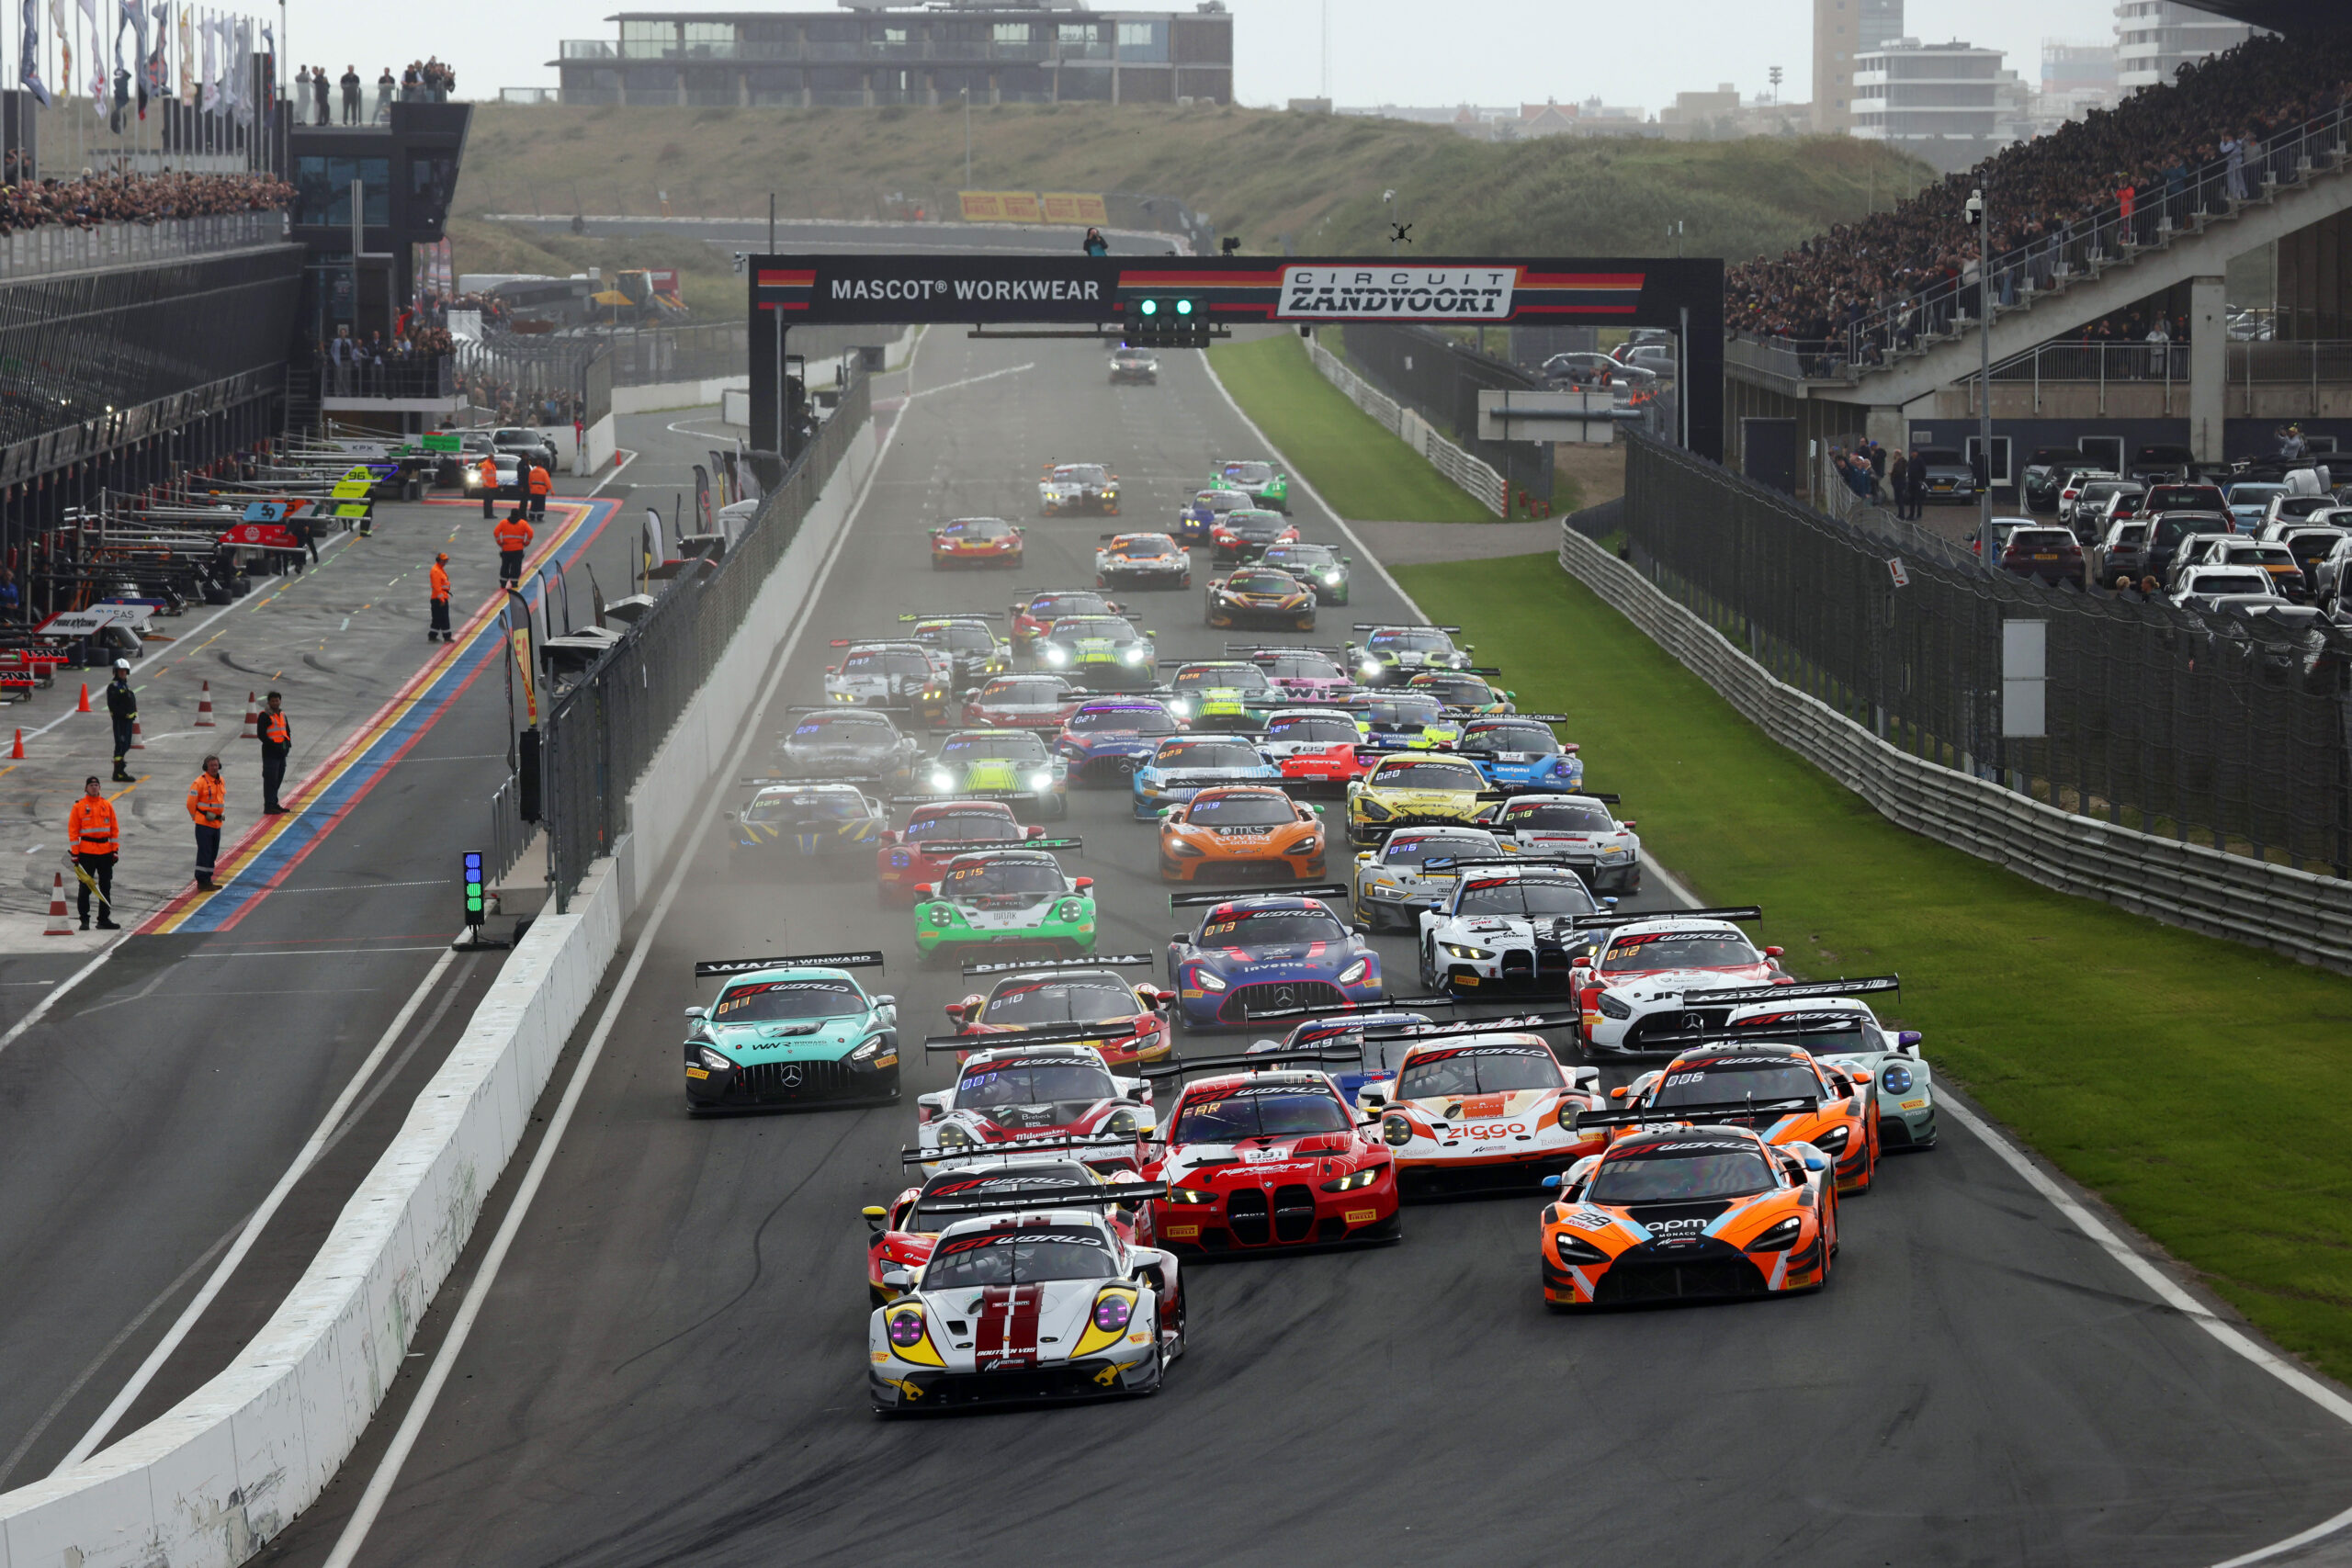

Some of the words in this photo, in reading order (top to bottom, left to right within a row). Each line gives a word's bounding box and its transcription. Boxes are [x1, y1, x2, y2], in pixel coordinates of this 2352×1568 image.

[1295, 272, 1504, 285] CIRCUIT
[955, 280, 1099, 299] WORKWEAR
[1288, 288, 1502, 312] ZANDVOORT
[348, 471, 366, 480] 96
[261, 504, 276, 519] 59
[1075, 715, 1097, 724] 027
[1300, 718, 1353, 728] WORLD
[1413, 762, 1473, 773] WORLD
[1376, 770, 1400, 781] 020
[1541, 804, 1603, 814] WORLD
[1216, 835, 1271, 843] NOVEM
[1424, 837, 1489, 846] WORLD
[1390, 843, 1417, 855] 016
[1467, 878, 1520, 889] GT
[1506, 879, 1579, 887] WORLD
[1216, 910, 1265, 922] GT
[1253, 910, 1326, 919] WORLD
[1205, 922, 1237, 937] 013
[1617, 933, 1672, 947] GT
[1658, 933, 1738, 942] WORLD
[799, 955, 871, 964] WINWARD
[1607, 945, 1641, 961] 012
[1456, 977, 1478, 986] PIRELLI
[729, 981, 784, 998] GT
[770, 983, 849, 992] WORLD
[1001, 984, 1056, 997] GT
[1039, 983, 1121, 991] WORLD
[718, 996, 752, 1015] 011
[991, 994, 1023, 1010] 010
[1738, 1012, 1797, 1026] GT
[1784, 1012, 1872, 1022] WORLD
[1302, 1026, 1362, 1041] GT
[877, 1056, 898, 1066] PIRELLI
[1410, 1048, 1474, 1065] GT
[1456, 1047, 1549, 1057] WORLD
[967, 1057, 1029, 1075] GT
[1012, 1056, 1102, 1067] WORLD
[1670, 1057, 1732, 1072] GT
[1715, 1056, 1811, 1066] WORLD
[688, 1070, 708, 1079] PIRELLI
[961, 1073, 998, 1090] 007
[1186, 1088, 1247, 1105] GT
[1235, 1087, 1330, 1097] WORLD
[1182, 1103, 1221, 1119] FAR
[1900, 1100, 1926, 1110] PIRELLI
[1014, 1129, 1067, 1141] Milwaukee
[1447, 1122, 1526, 1140] ziggo
[1249, 1151, 1283, 1159] 991
[1605, 1142, 1676, 1160] GT
[1657, 1141, 1761, 1152] WORLD
[930, 1177, 999, 1196] GT
[979, 1177, 1080, 1187] WORLD
[1347, 1212, 1376, 1222] PIRELLI
[1572, 1212, 1612, 1227] 58
[1566, 1219, 1594, 1230] ROWE
[1645, 1219, 1707, 1233] apm
[1168, 1226, 1197, 1237] PIRELLI
[941, 1235, 1014, 1255] GT
[994, 1235, 1102, 1247] WORLD
[1788, 1276, 1810, 1287] PIRELLI
[1555, 1292, 1575, 1301] PIRELLI
[1129, 1335, 1153, 1344] PIRELLI
